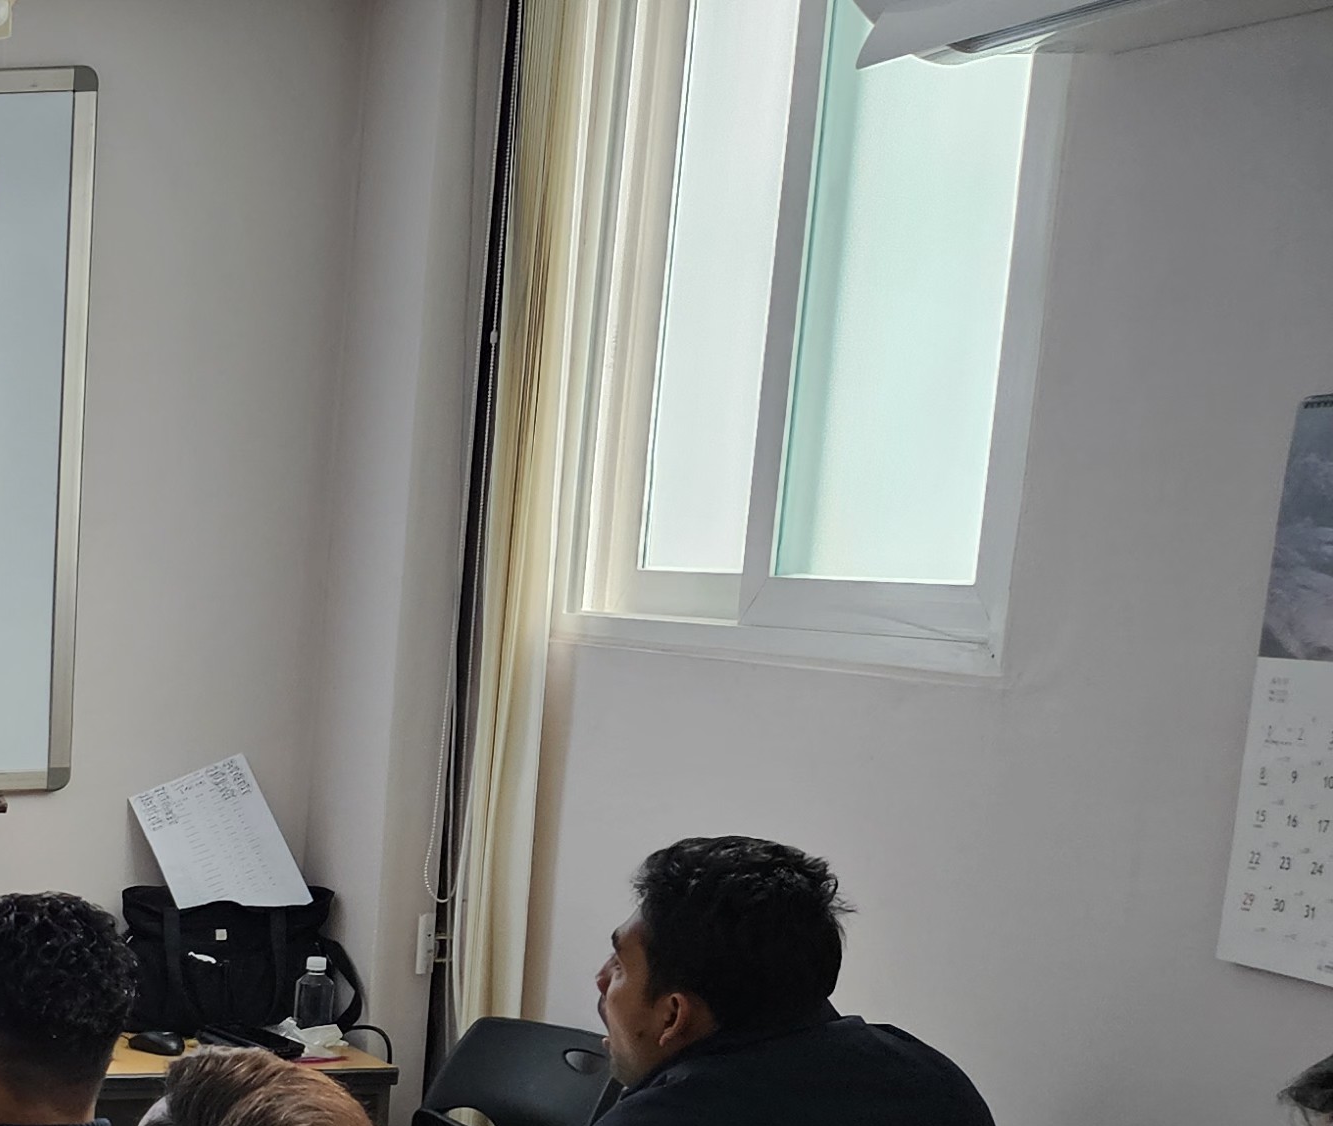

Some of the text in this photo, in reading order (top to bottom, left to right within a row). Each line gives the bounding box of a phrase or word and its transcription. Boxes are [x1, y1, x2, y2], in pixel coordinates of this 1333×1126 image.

[1291, 770, 1298, 784] 9
[1255, 809, 1330, 833] 15 16 17
[1248, 850, 1324, 876] 22 23 24
[1242, 892, 1316, 920] 29 30 31
